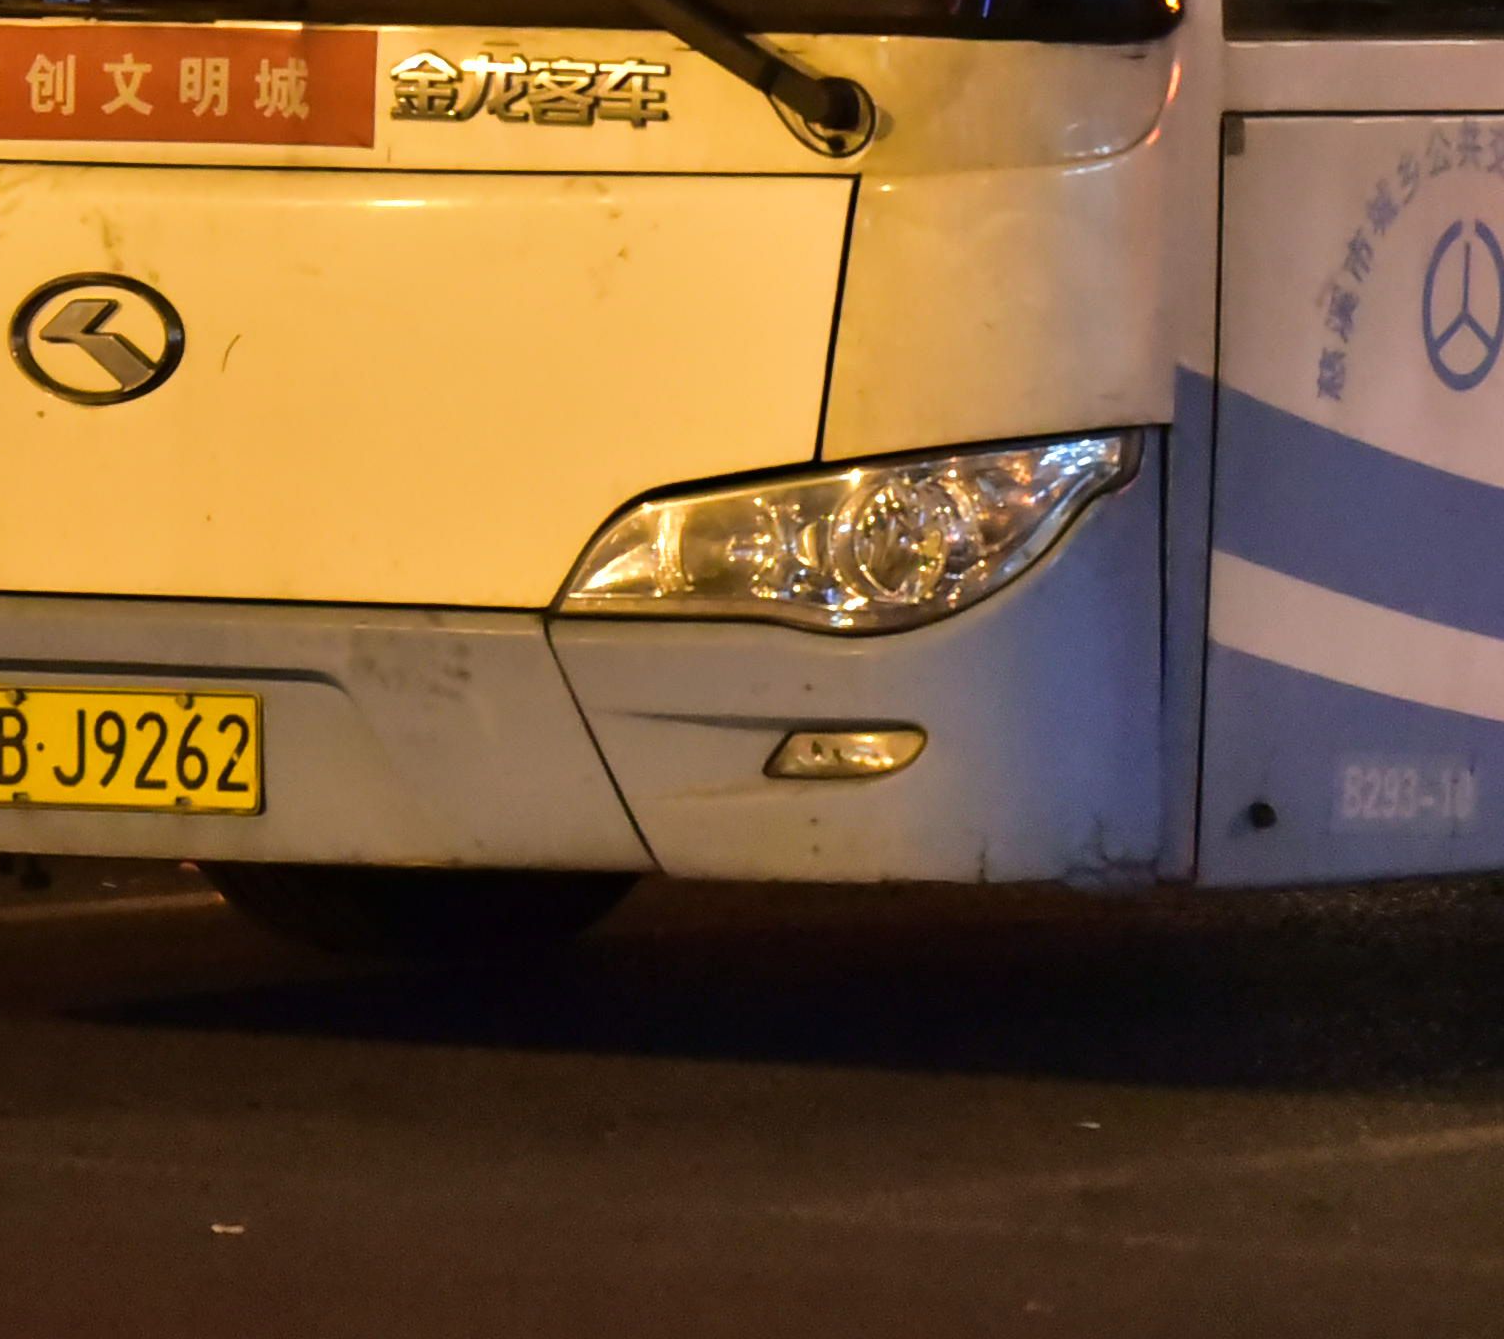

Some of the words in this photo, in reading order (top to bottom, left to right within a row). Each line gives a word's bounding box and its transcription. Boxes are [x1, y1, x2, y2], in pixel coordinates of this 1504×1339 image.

[388, 47, 671, 129] 金龙客车
[1343, 765, 1475, 821] B293-10
